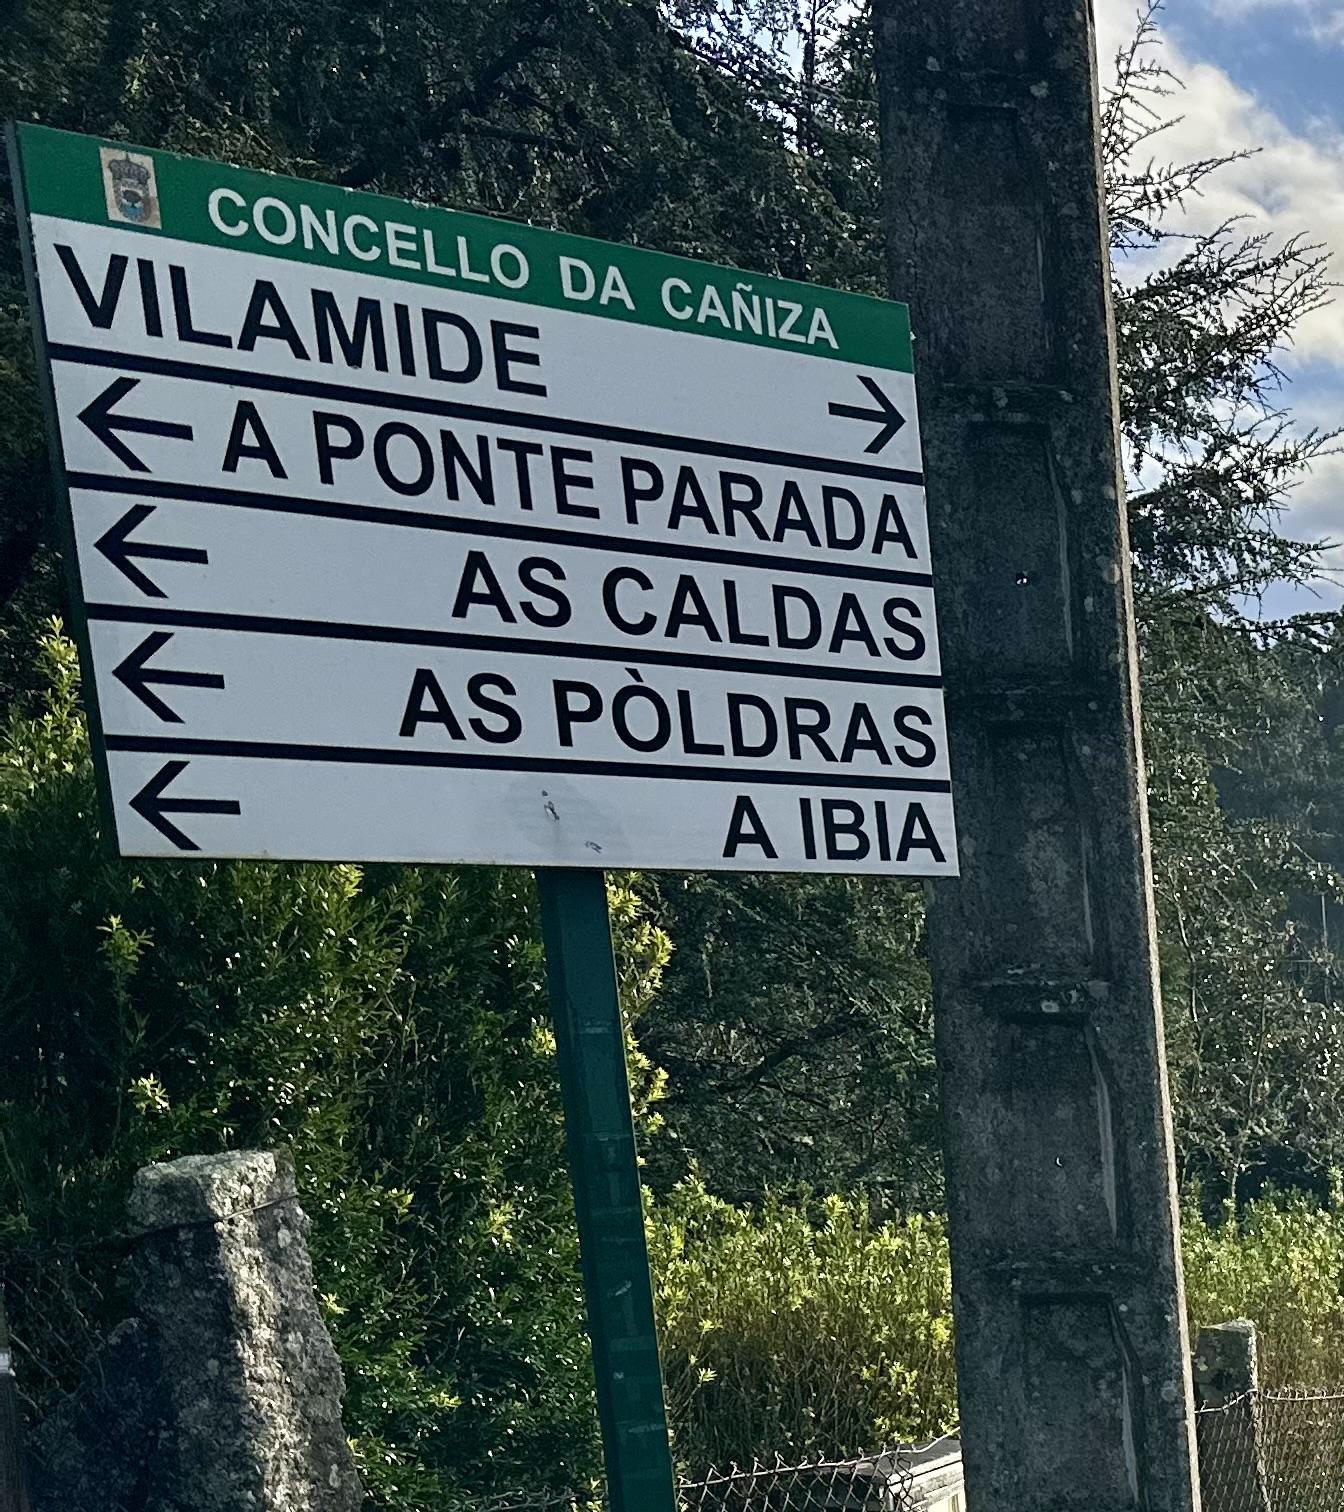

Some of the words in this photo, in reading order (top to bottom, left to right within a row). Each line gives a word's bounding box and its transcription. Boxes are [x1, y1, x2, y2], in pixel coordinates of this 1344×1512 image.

[53, 244, 547, 397] VILAMIDE
[209, 188, 529, 288] CONCELLO
[560, 256, 635, 310] DA
[662, 278, 839, 349] CAÑIZA
[222, 400, 288, 479] A
[313, 411, 600, 519] PONTE
[621, 456, 918, 559] PARADA
[452, 550, 571, 627] AS
[603, 567, 925, 660] CALDAS
[399, 669, 522, 743] AS
[553, 668, 936, 767] PÒLDRAS
[723, 796, 778, 858] A
[800, 798, 946, 862] IBIA
